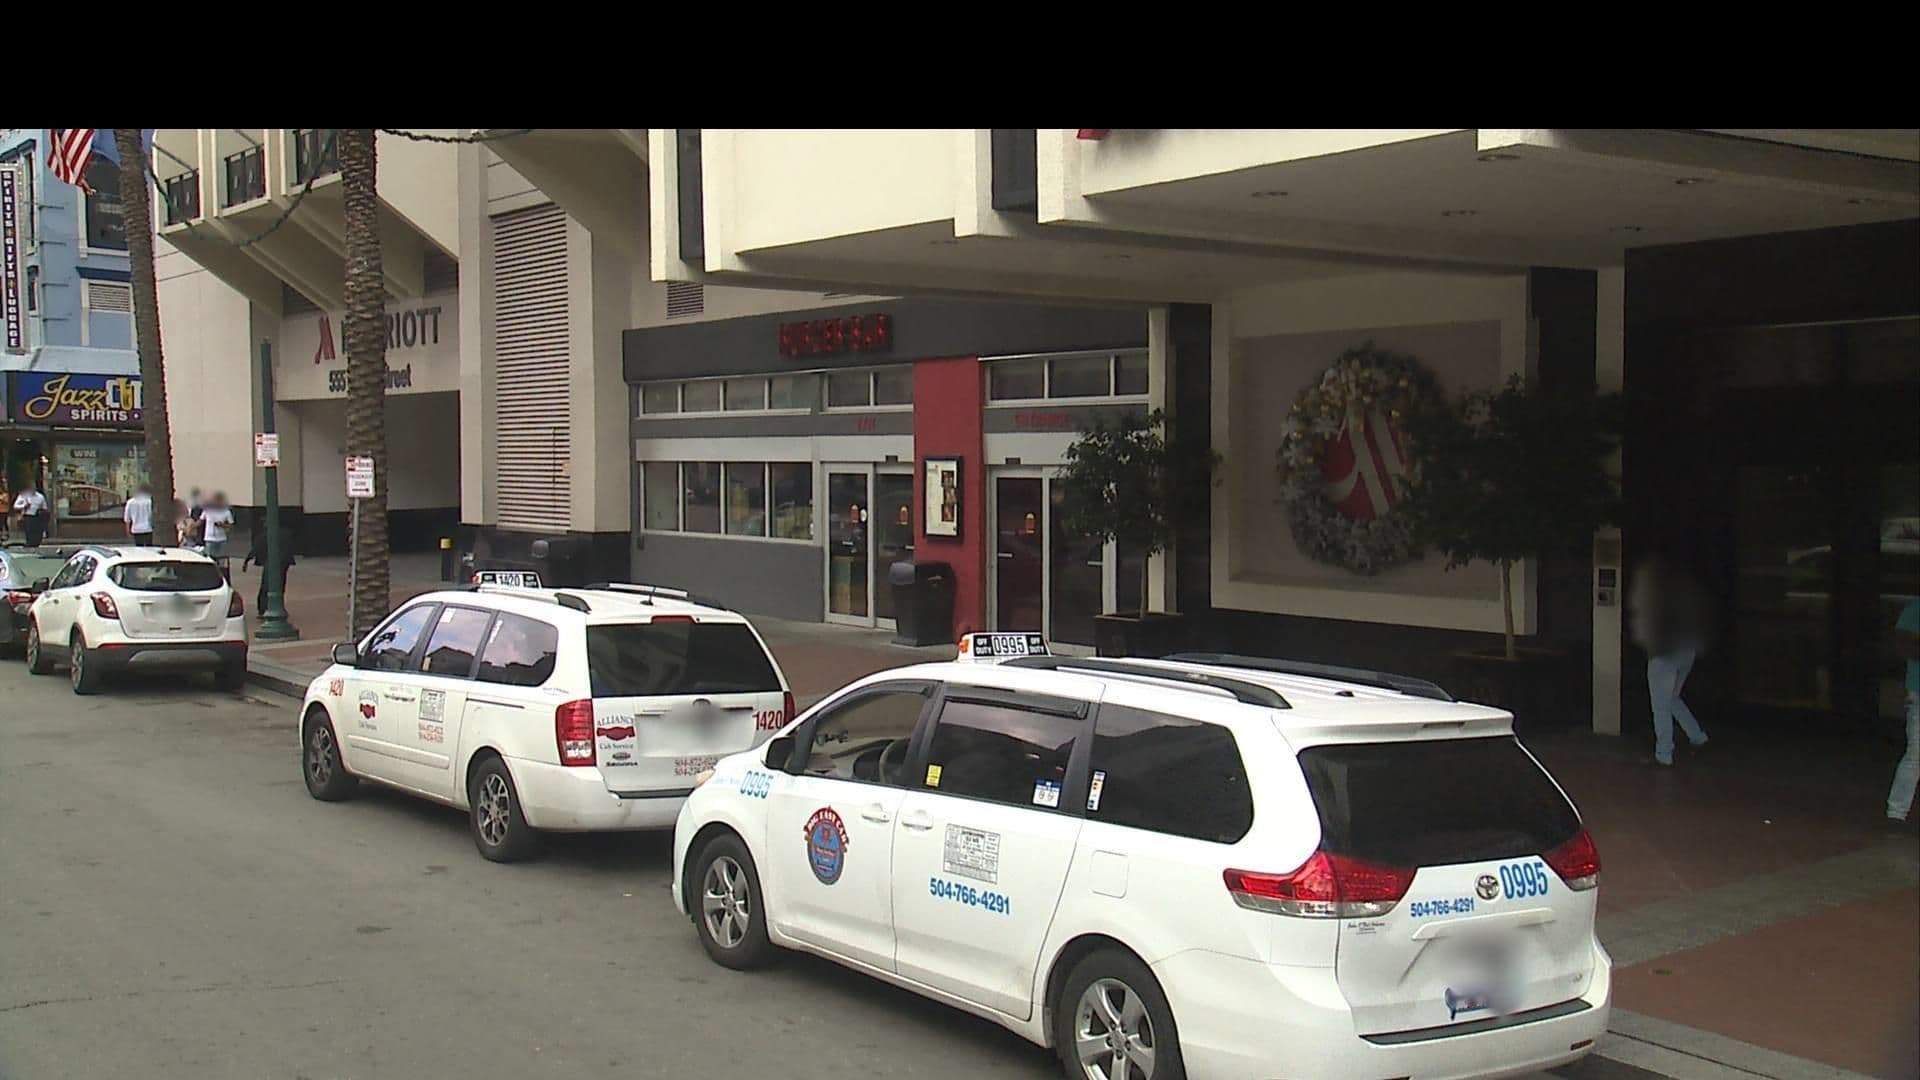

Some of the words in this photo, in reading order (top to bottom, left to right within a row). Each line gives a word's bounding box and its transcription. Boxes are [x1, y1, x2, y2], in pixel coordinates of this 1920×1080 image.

[3, 171, 14, 227] SPIRITS
[5, 237, 15, 278] GIFTS
[8, 288, 18, 347] LUGGAGE
[25, 374, 109, 418] Jazz
[71, 409, 128, 422] SPIRITS
[992, 636, 1025, 654] 0995
[753, 710, 783, 731] 1420
[740, 770, 774, 799] 0995
[930, 877, 1010, 915] 504-766-4291
[1500, 862, 1549, 900] 0995
[1410, 897, 1475, 918] 504-766-4291
